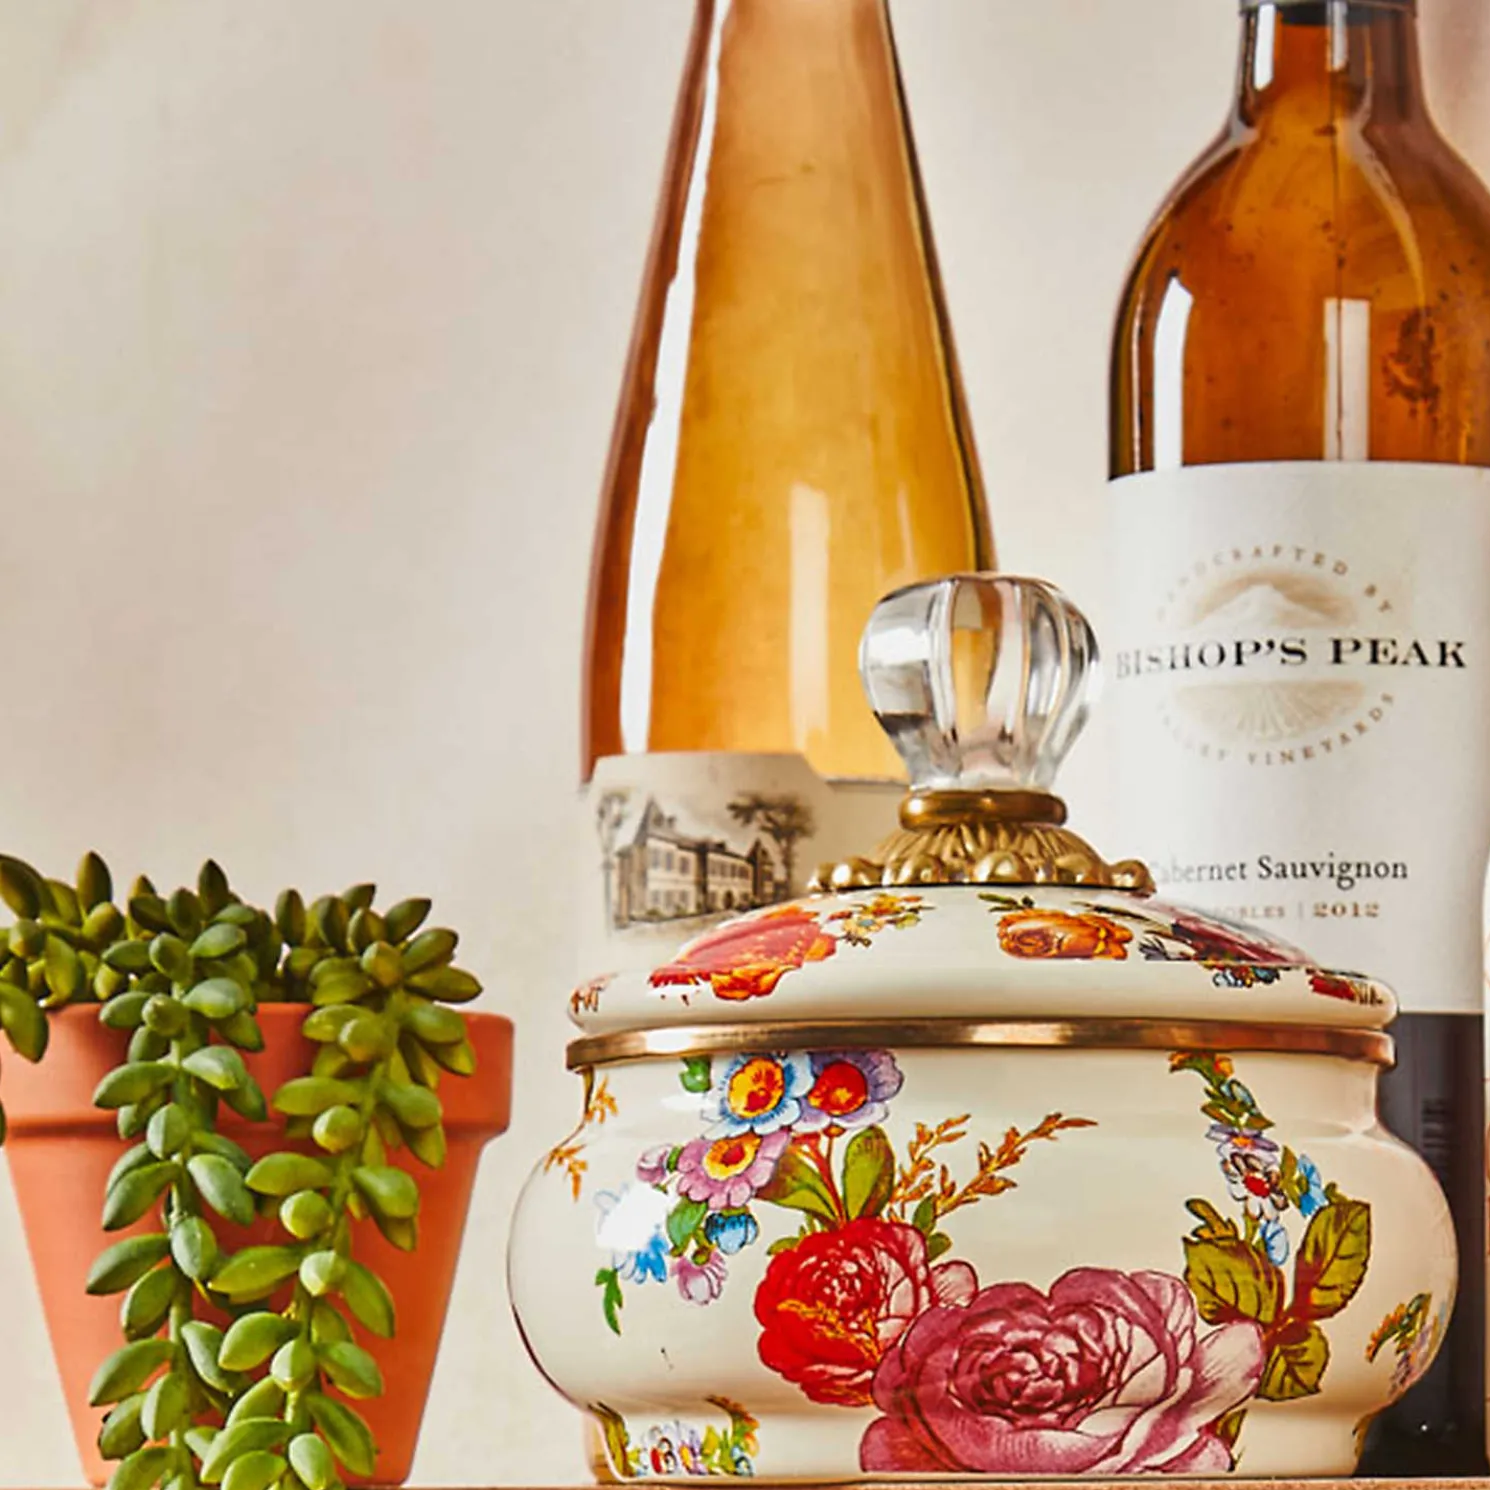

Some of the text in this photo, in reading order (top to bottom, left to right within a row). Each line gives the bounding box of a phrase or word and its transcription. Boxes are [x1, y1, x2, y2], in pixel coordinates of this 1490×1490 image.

[1115, 637, 1467, 679] BISHOP'S PEAK
[1257, 852, 1408, 891] Sauvignon
[1312, 901, 1380, 918] 2012
